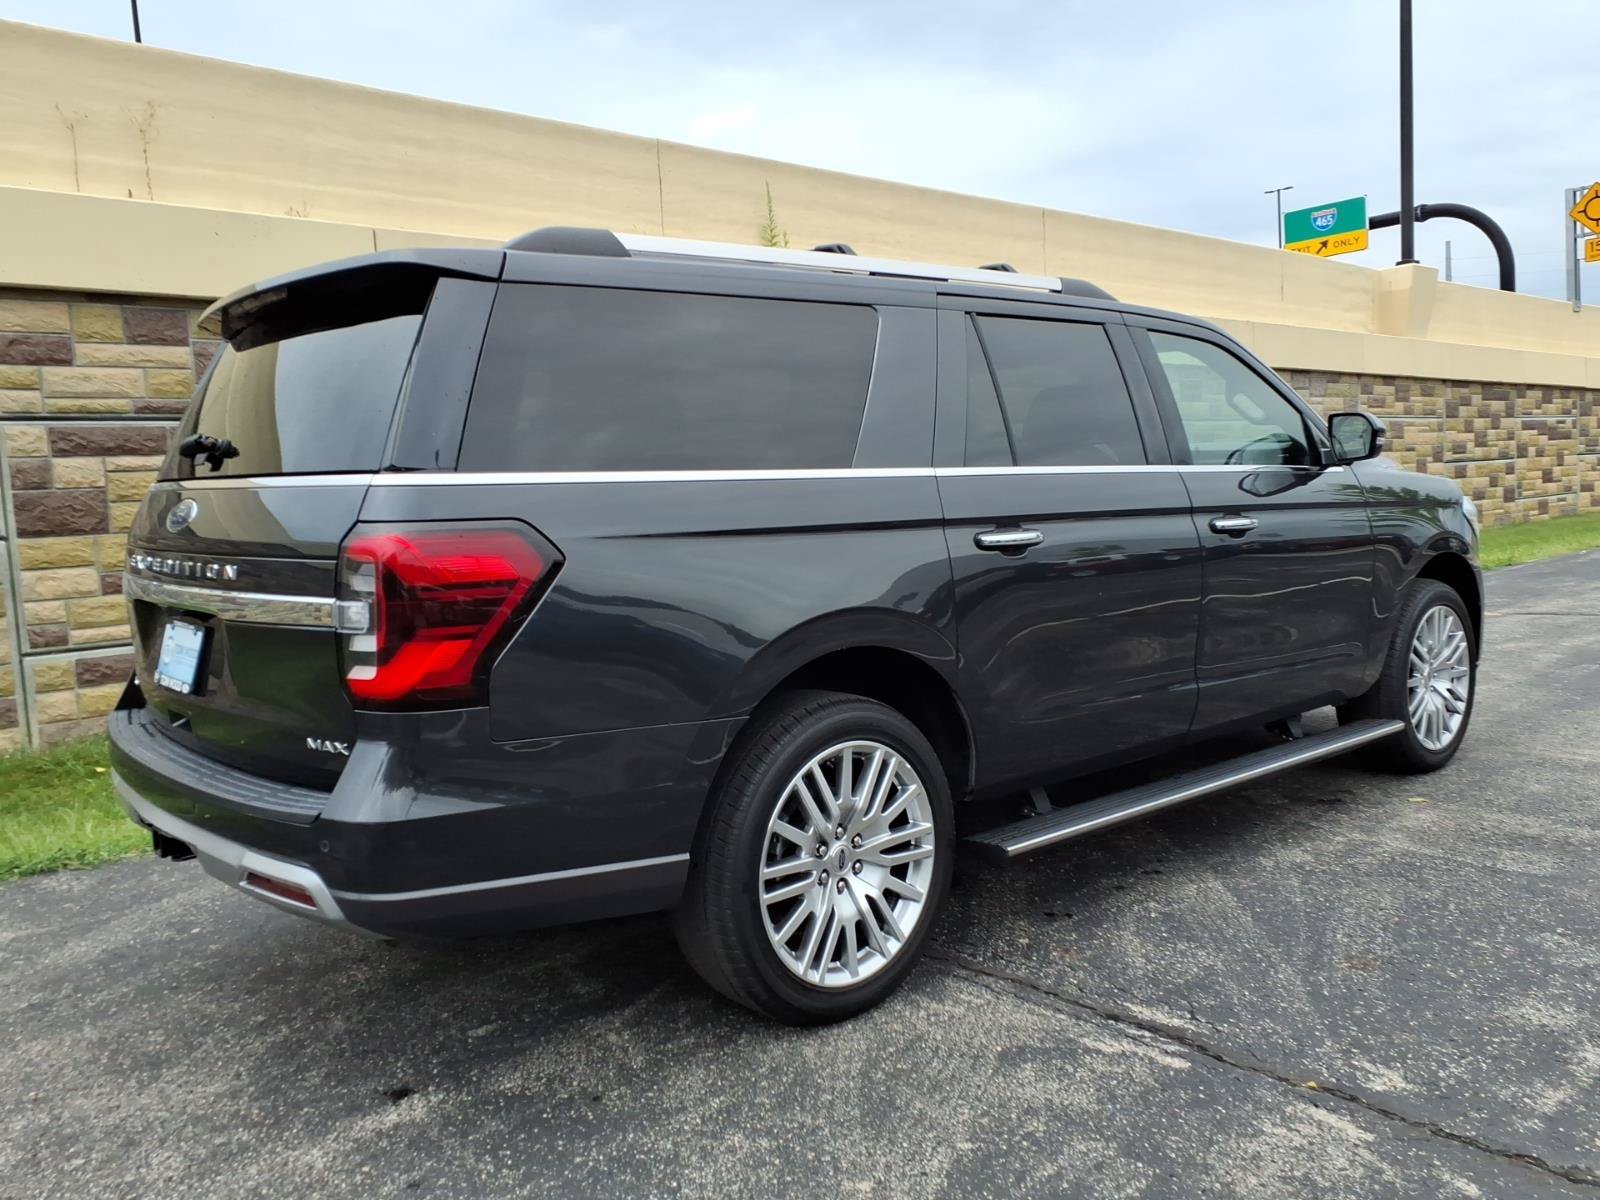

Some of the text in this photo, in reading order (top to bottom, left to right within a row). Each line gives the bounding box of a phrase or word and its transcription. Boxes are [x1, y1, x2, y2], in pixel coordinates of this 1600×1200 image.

[1315, 214, 1333, 227] 465
[1291, 236, 1360, 254] XIT ONLY
[306, 738, 349, 756] MAX
